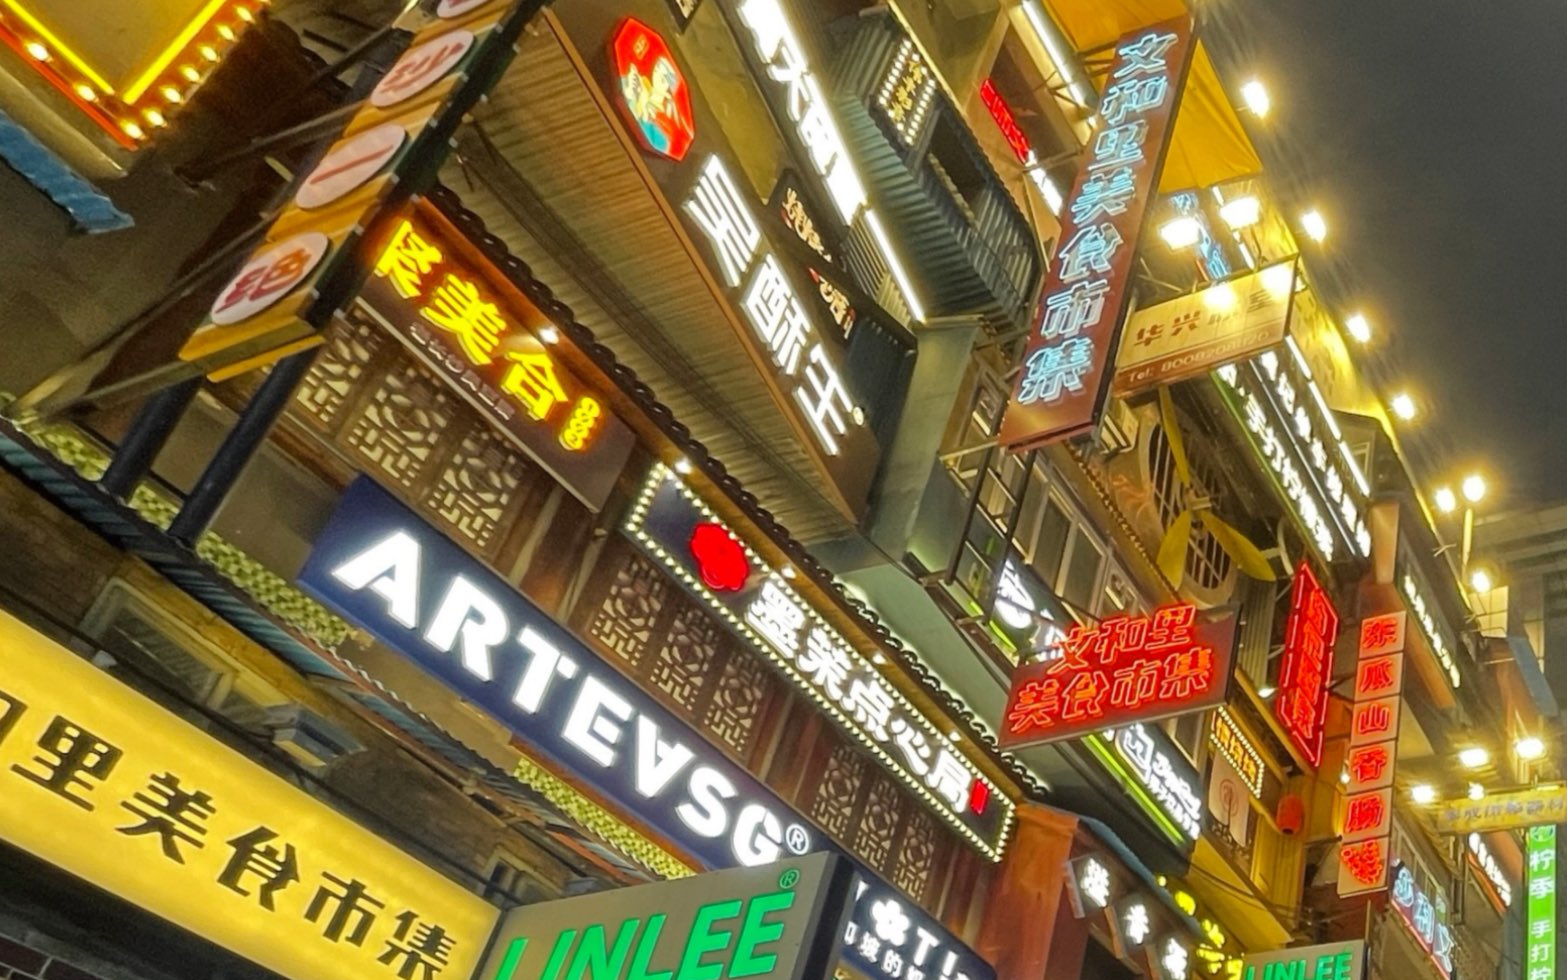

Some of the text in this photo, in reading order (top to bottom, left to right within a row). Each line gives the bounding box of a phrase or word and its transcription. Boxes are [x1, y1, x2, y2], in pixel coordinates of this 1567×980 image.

[998, 33, 1178, 404] 文和里美食市集
[374, 220, 568, 420] 聚美合
[746, 580, 972, 812] 墨茉点心局
[1009, 647, 1212, 733] 美食市集
[1047, 605, 1196, 675] 文和里
[1528, 848, 1554, 899] 柠季
